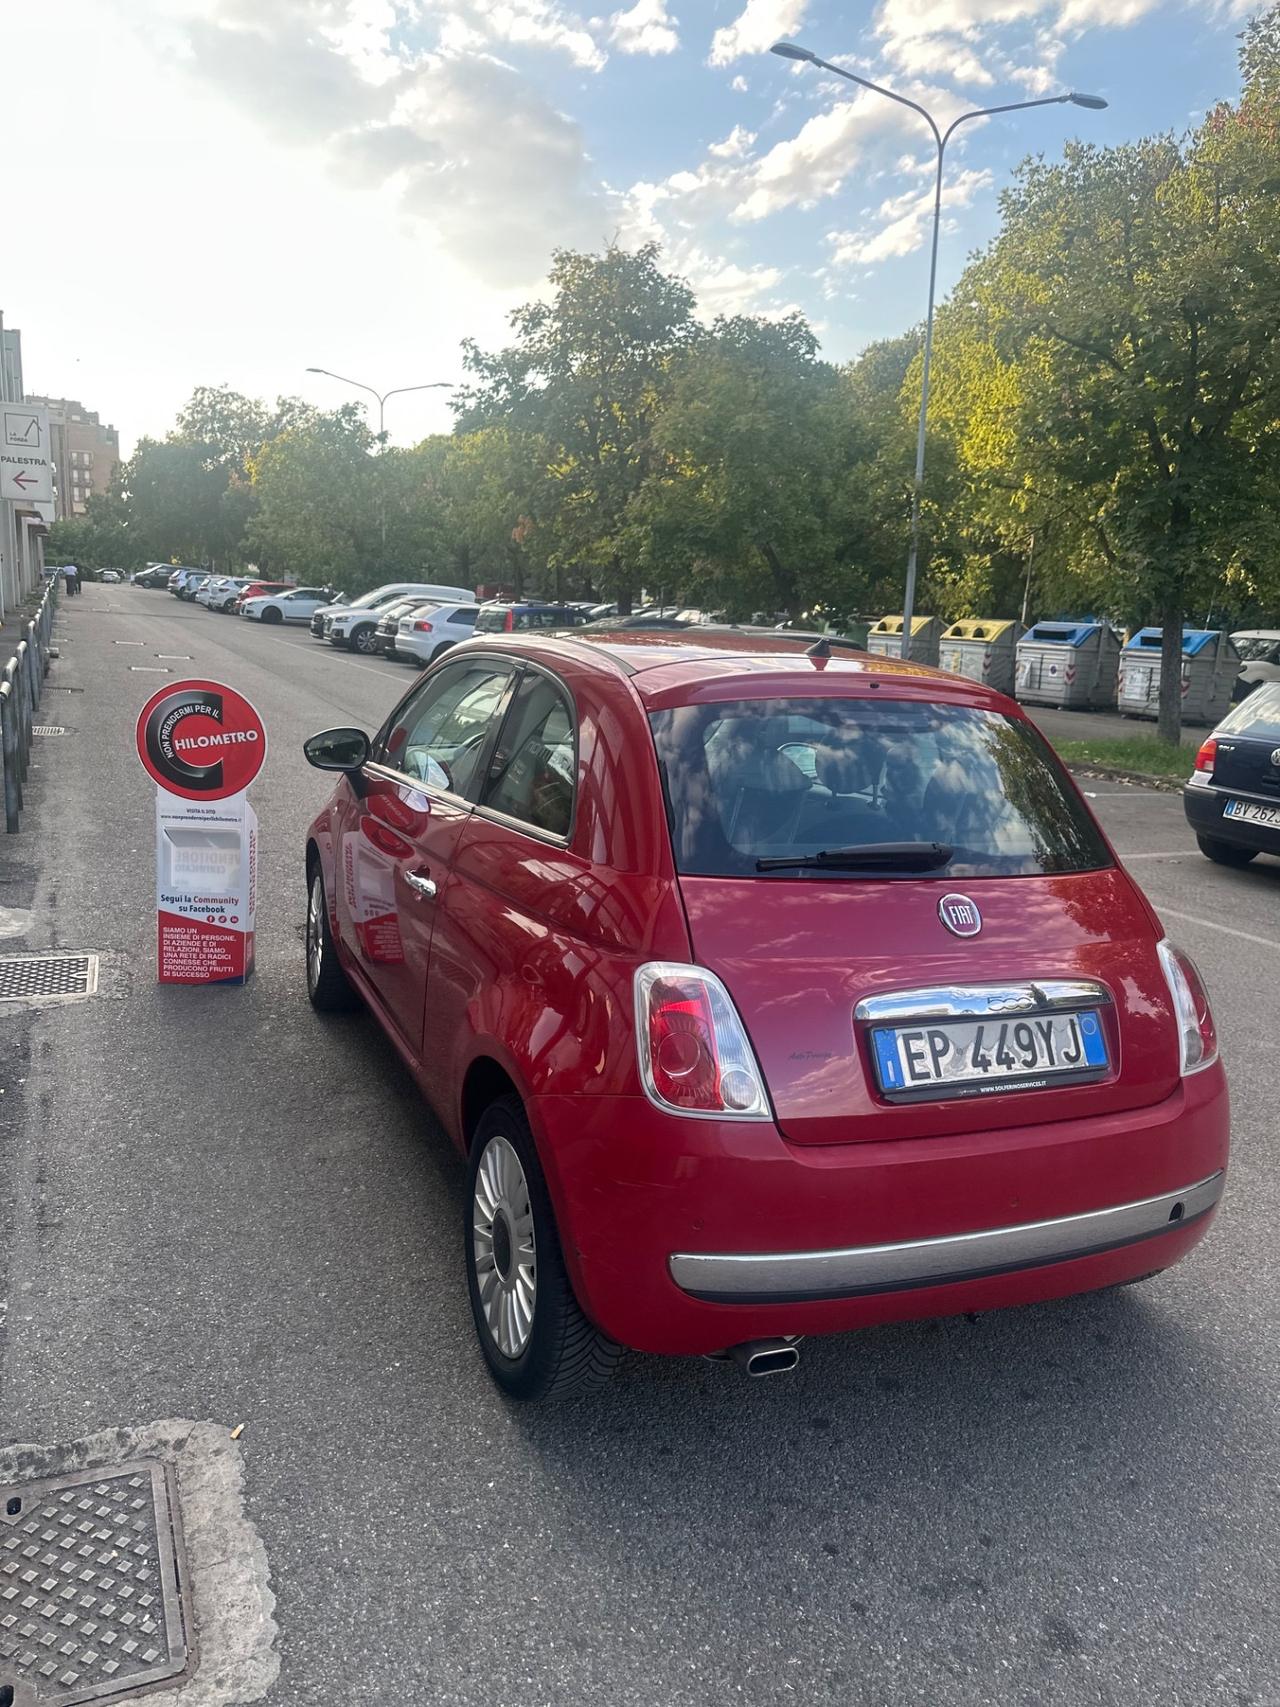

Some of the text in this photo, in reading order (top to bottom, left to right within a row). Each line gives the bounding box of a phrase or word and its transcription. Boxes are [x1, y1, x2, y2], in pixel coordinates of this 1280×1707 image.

[0, 456, 47, 466] PALESTRA
[161, 704, 220, 759] NON PRENDERMI PER IL
[1234, 801, 1251, 817] BV
[161, 894, 240, 906] Segui la Community
[189, 905, 226, 913] Facebook
[948, 905, 974, 926] FIAT
[902, 1030, 950, 1081] EP
[971, 1018, 1082, 1073] 449YJ
[980, 1080, 1047, 1093] WWW.SOLFERINOSERVICES.IT
